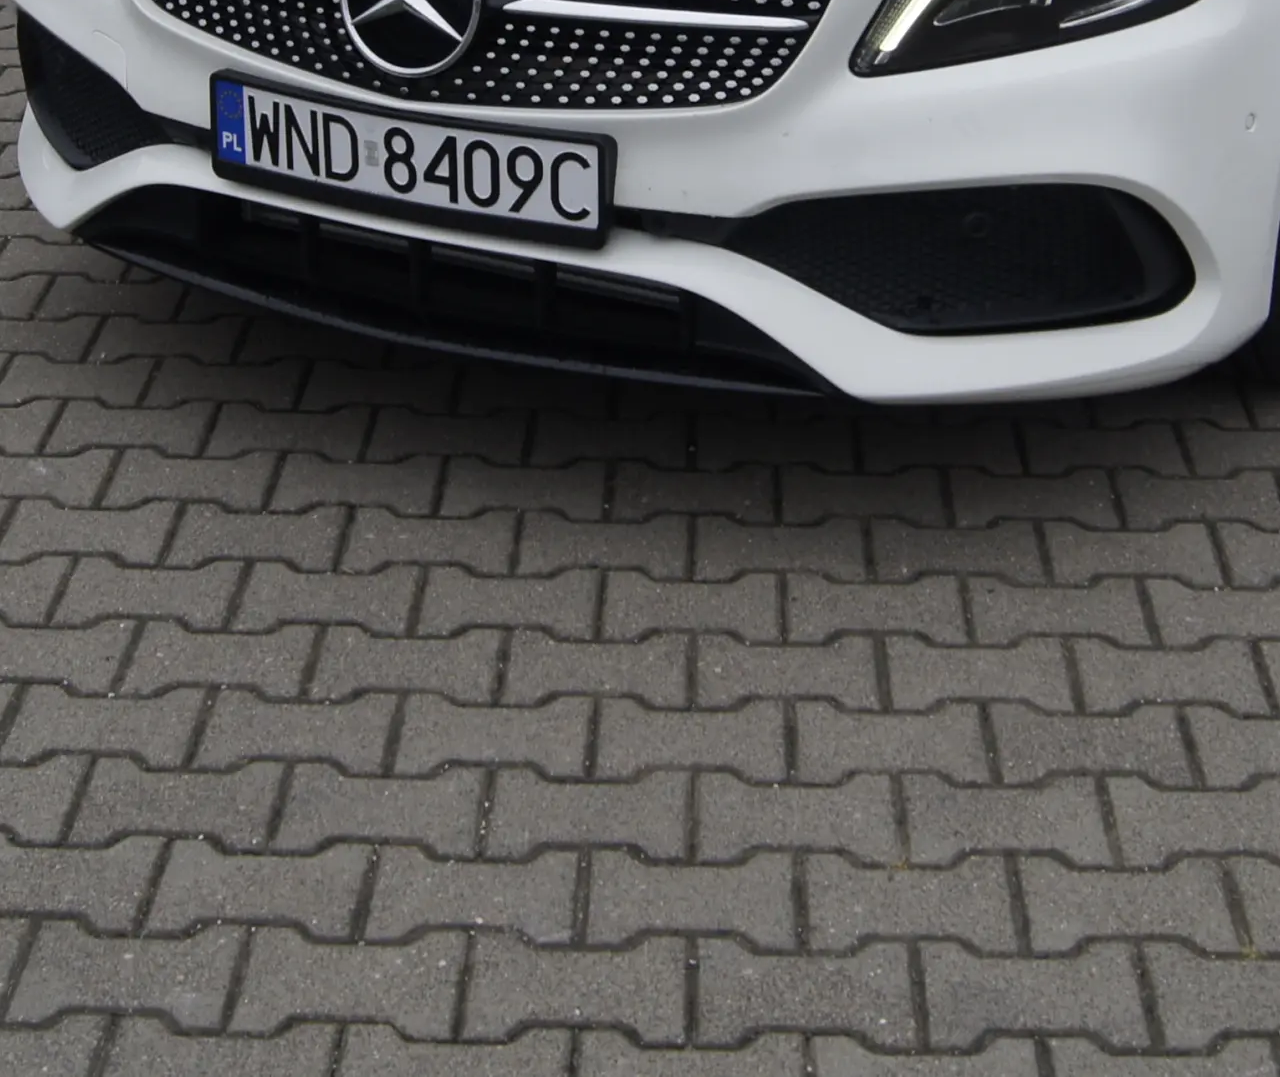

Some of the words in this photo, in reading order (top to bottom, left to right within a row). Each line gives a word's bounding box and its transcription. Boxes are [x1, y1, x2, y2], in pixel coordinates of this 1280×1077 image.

[222, 130, 243, 153] PL
[247, 94, 360, 183] WND
[382, 125, 593, 223] 8409C
